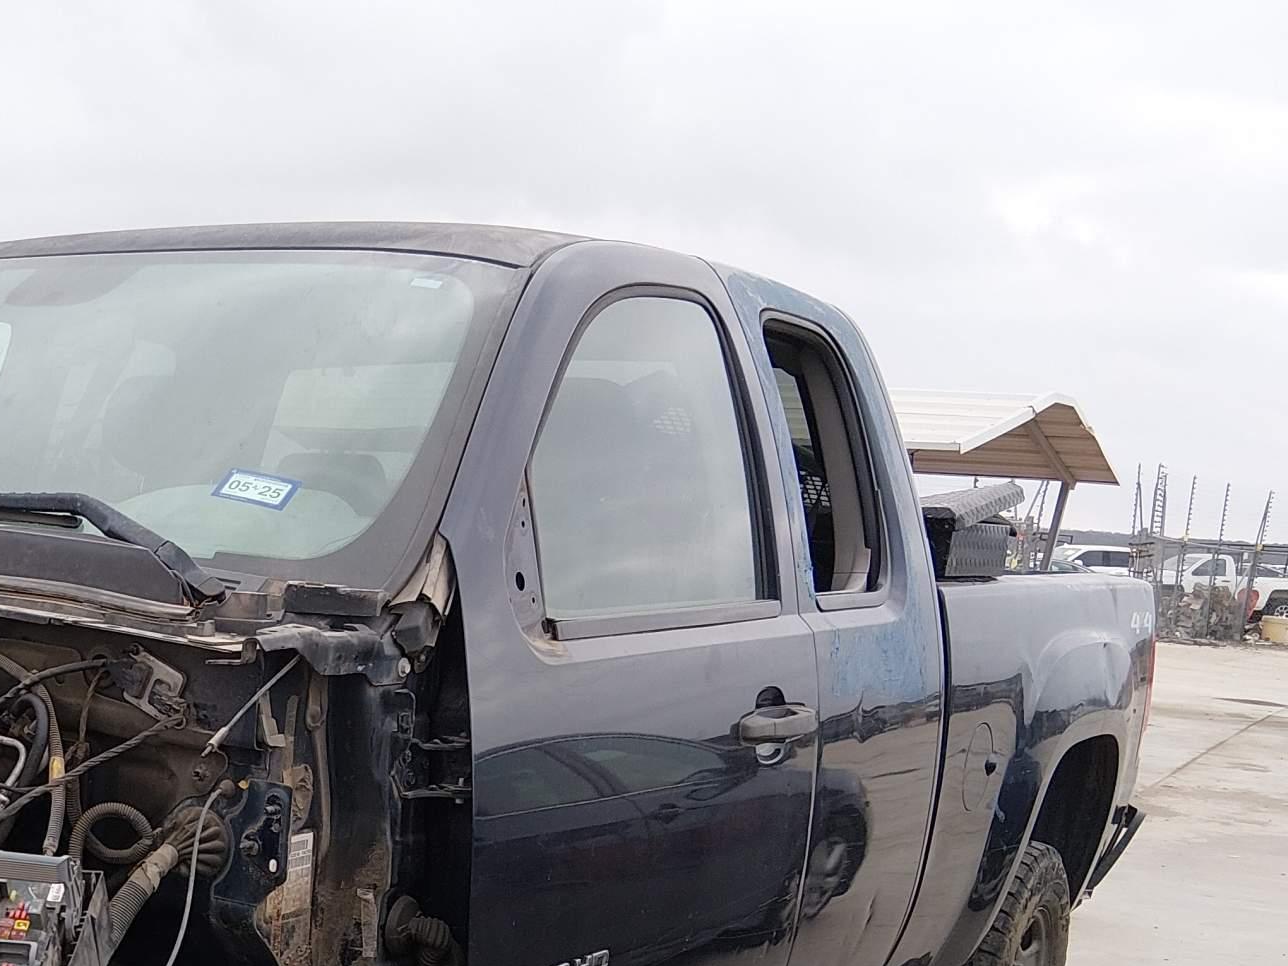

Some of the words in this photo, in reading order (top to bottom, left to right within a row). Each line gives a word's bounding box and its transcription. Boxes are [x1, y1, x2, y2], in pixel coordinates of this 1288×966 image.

[228, 480, 252, 492] 05
[257, 485, 283, 499] 25
[1130, 611, 1153, 635] 44
